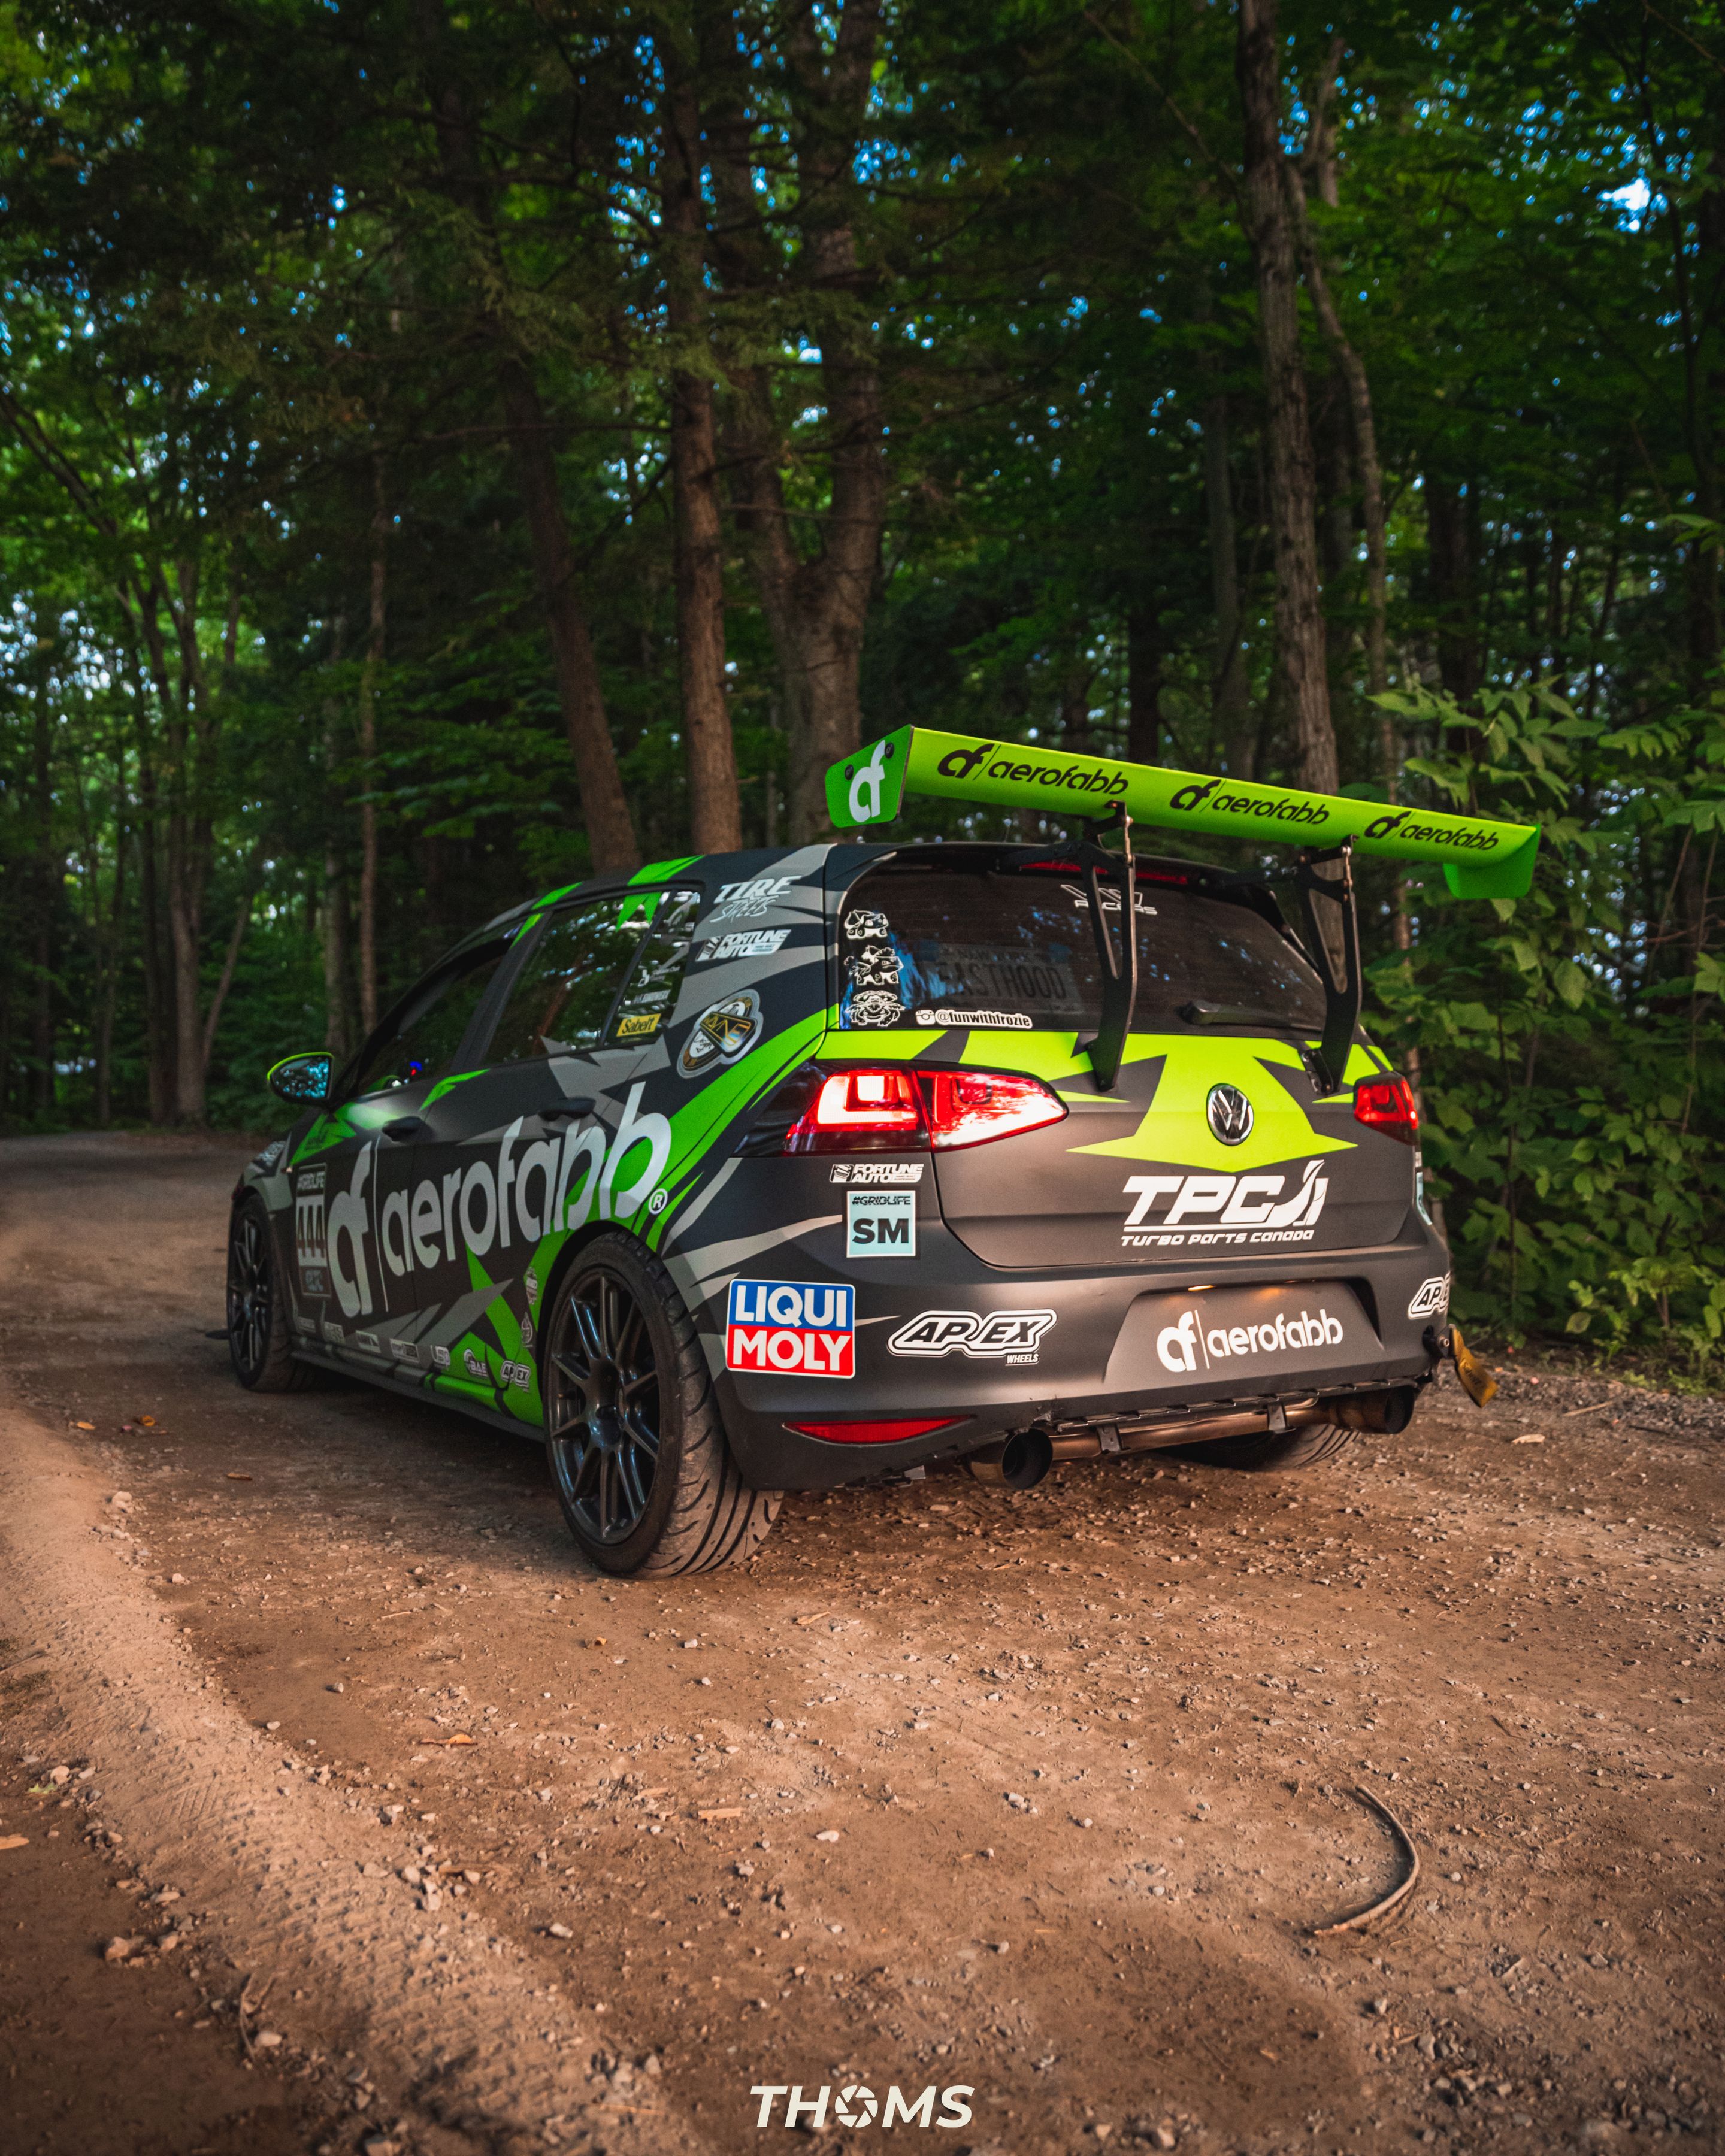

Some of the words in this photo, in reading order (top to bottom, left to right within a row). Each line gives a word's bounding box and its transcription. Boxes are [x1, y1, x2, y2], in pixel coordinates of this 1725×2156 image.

[988, 757, 1129, 795] aerofabb
[1212, 794, 1330, 825] aerofabb
[1400, 823, 1499, 851] aerofabb
[713, 875, 803, 904] TIRE
[710, 895, 780, 923] STREETS
[713, 944, 750, 959] AUTO
[723, 929, 792, 947] FORTUNE
[622, 1016, 655, 1034] Sabelt
[937, 1011, 1031, 1027] @funwithfrozie
[381, 1081, 671, 1277] aerofabb
[851, 1173, 891, 1183] AUTO
[853, 1164, 924, 1174] FORTUNE
[852, 1195, 911, 1206] #GRIDLIFE
[852, 1218, 909, 1244] SM
[734, 1285, 847, 1327] LIQUI
[1207, 1309, 1343, 1358] aerofabb
[733, 1330, 851, 1371] MOLY
[1006, 1353, 1039, 1364] WHEELS
